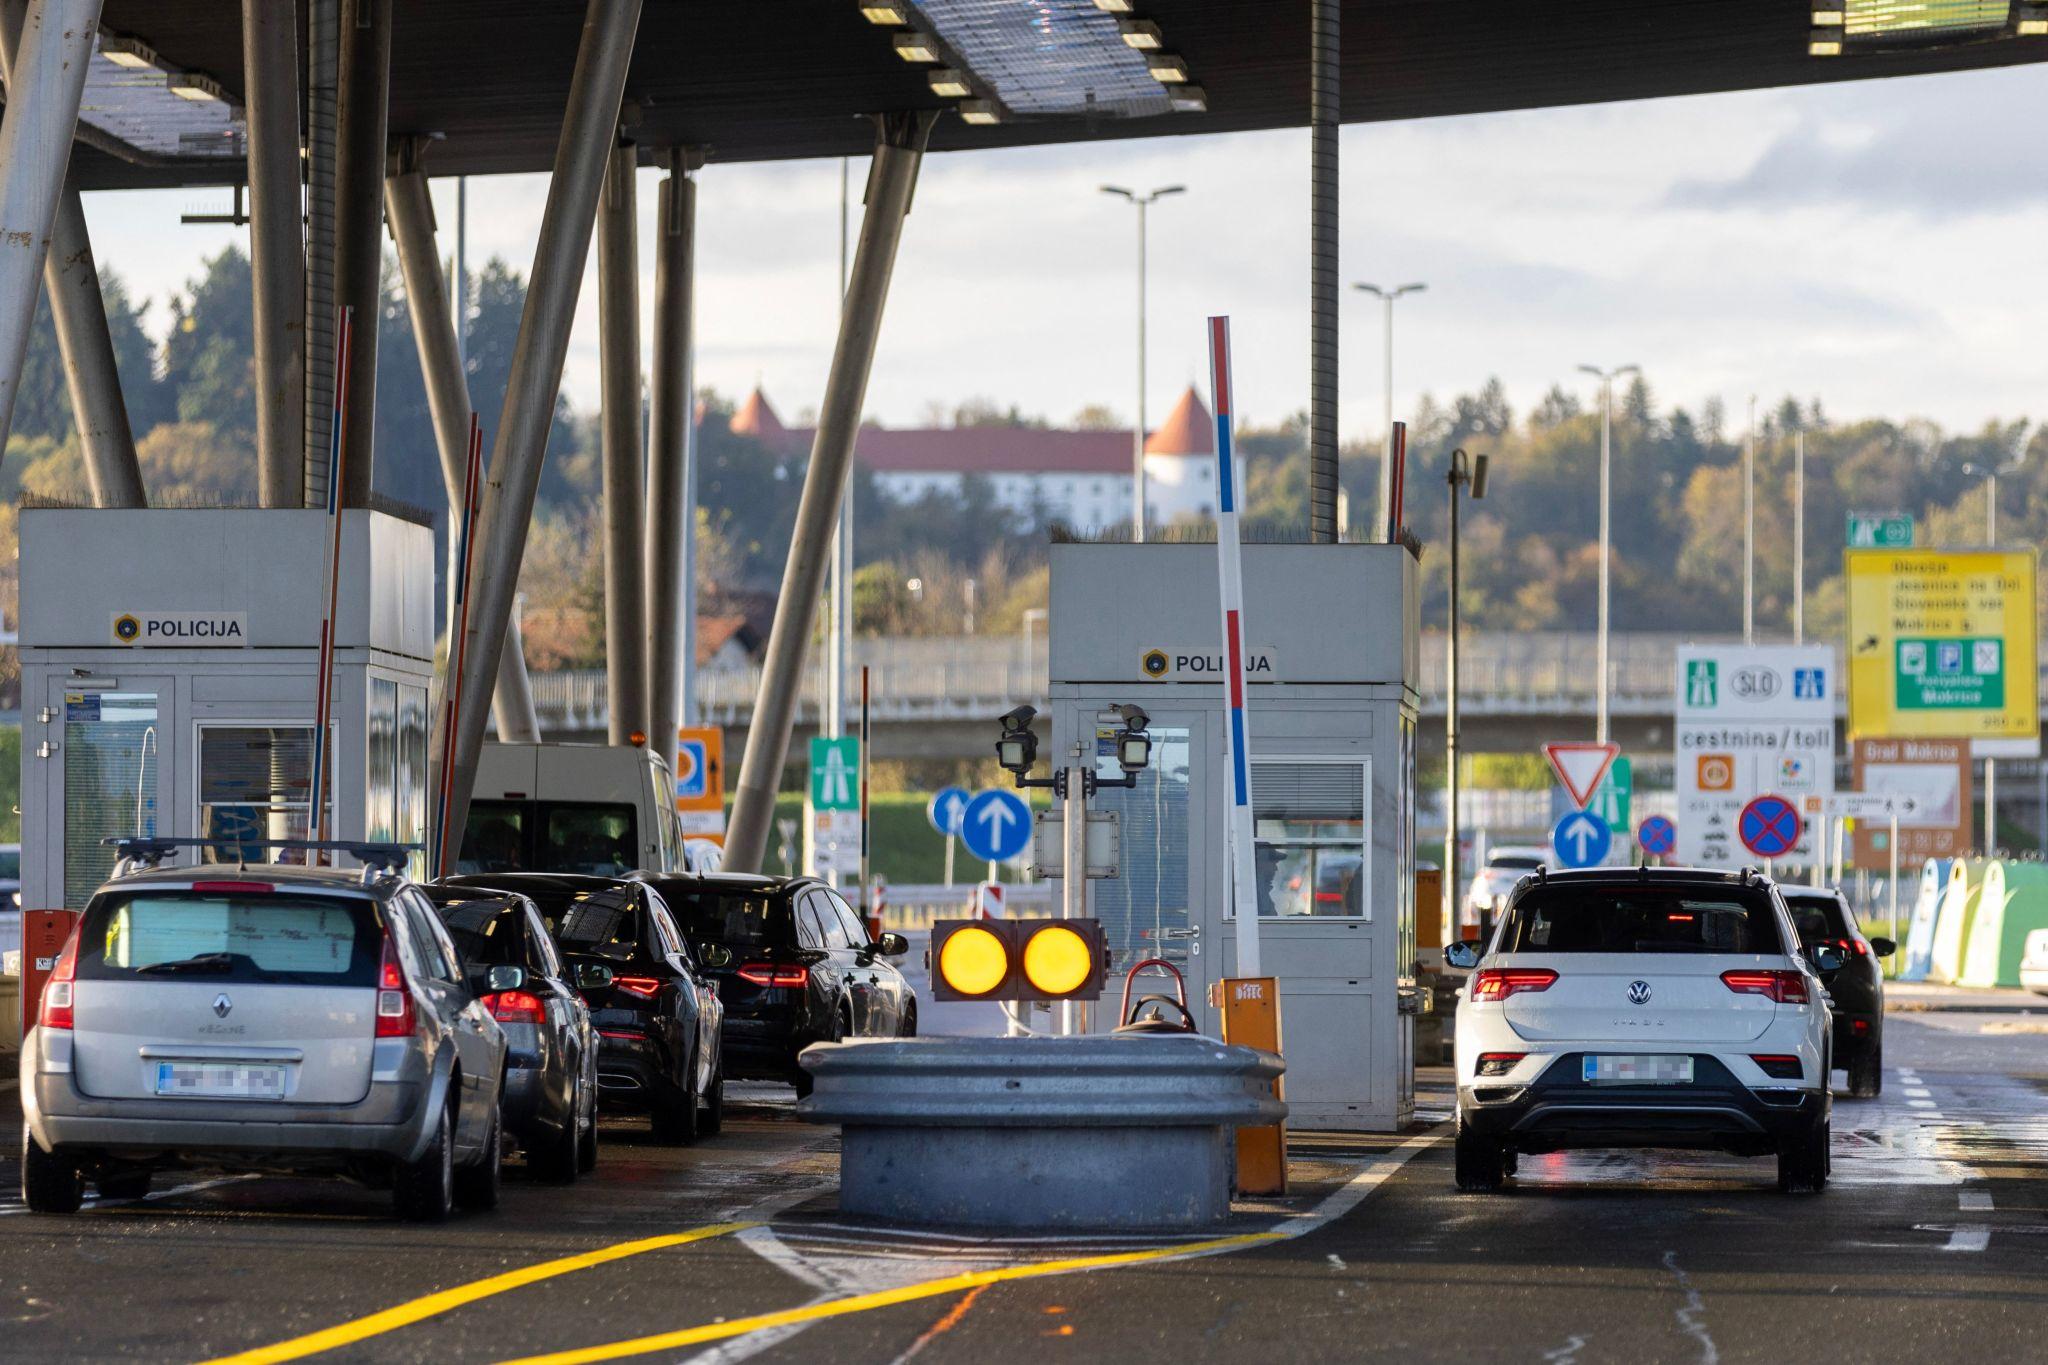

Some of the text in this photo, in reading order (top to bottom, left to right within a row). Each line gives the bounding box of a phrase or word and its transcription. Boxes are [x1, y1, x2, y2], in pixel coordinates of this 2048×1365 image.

[147, 620, 242, 636] POLICIJA
[1176, 655, 1271, 672] POLIJA
[1739, 669, 1773, 696] SLO
